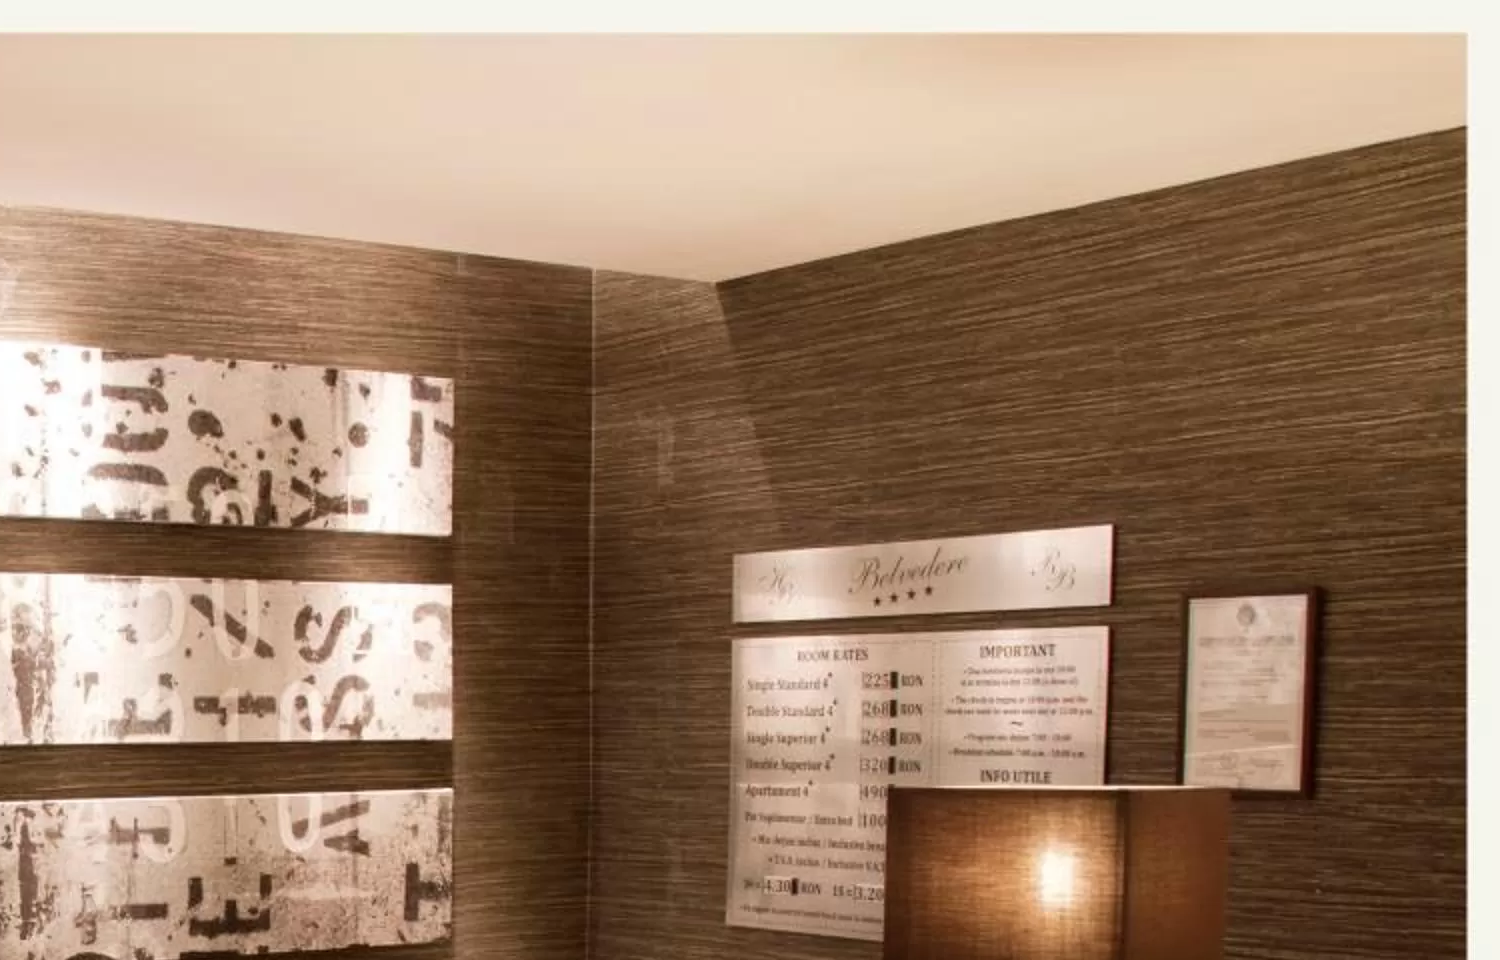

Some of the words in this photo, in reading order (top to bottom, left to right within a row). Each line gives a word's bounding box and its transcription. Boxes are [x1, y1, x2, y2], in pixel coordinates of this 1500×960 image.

[848, 545, 969, 593] Belvedere
[797, 650, 829, 662] ROOM
[833, 648, 869, 661] RATES
[980, 643, 1057, 659] IMPORTANT
[901, 674, 924, 687] RON
[901, 703, 923, 716] RON
[900, 731, 922, 745] RON
[899, 759, 921, 773] RON
[980, 768, 1010, 783] INFO
[1012, 769, 1052, 784] UTILE
